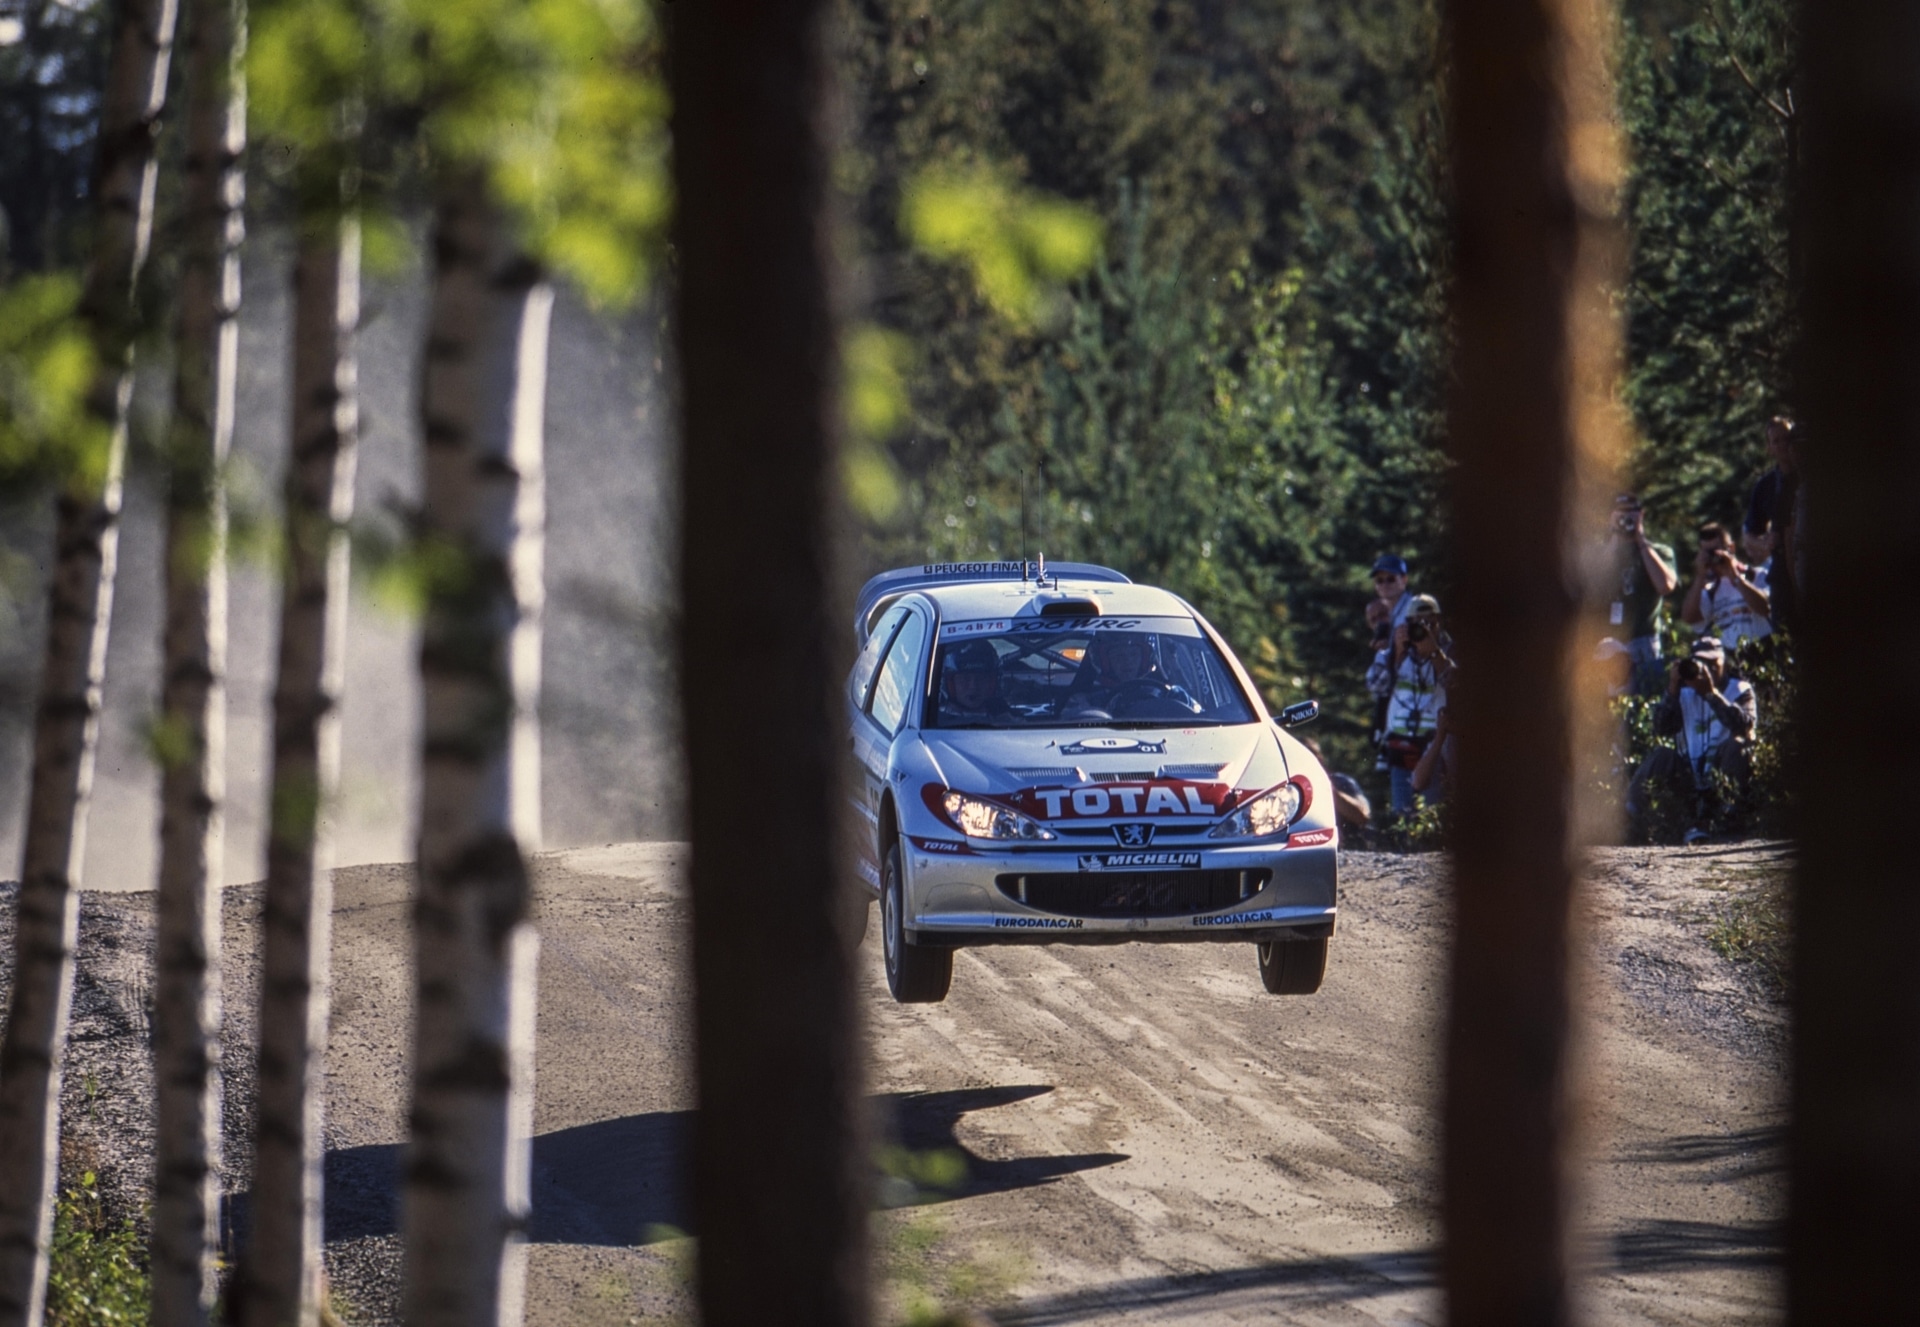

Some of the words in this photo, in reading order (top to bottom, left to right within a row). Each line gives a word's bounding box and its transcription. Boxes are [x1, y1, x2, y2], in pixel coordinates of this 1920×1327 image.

[935, 562, 989, 574] PEUGEOT
[991, 562, 1038, 572] FINANC
[1291, 708, 1318, 722] NIKKO
[1034, 785, 1217, 819] TOTAL
[1293, 832, 1330, 845] TOTAL
[922, 841, 959, 852] TOTAL
[1107, 852, 1200, 866] MICHELIN
[994, 918, 1084, 929] EURODATACAR
[1192, 911, 1274, 926] EURODATACAR
